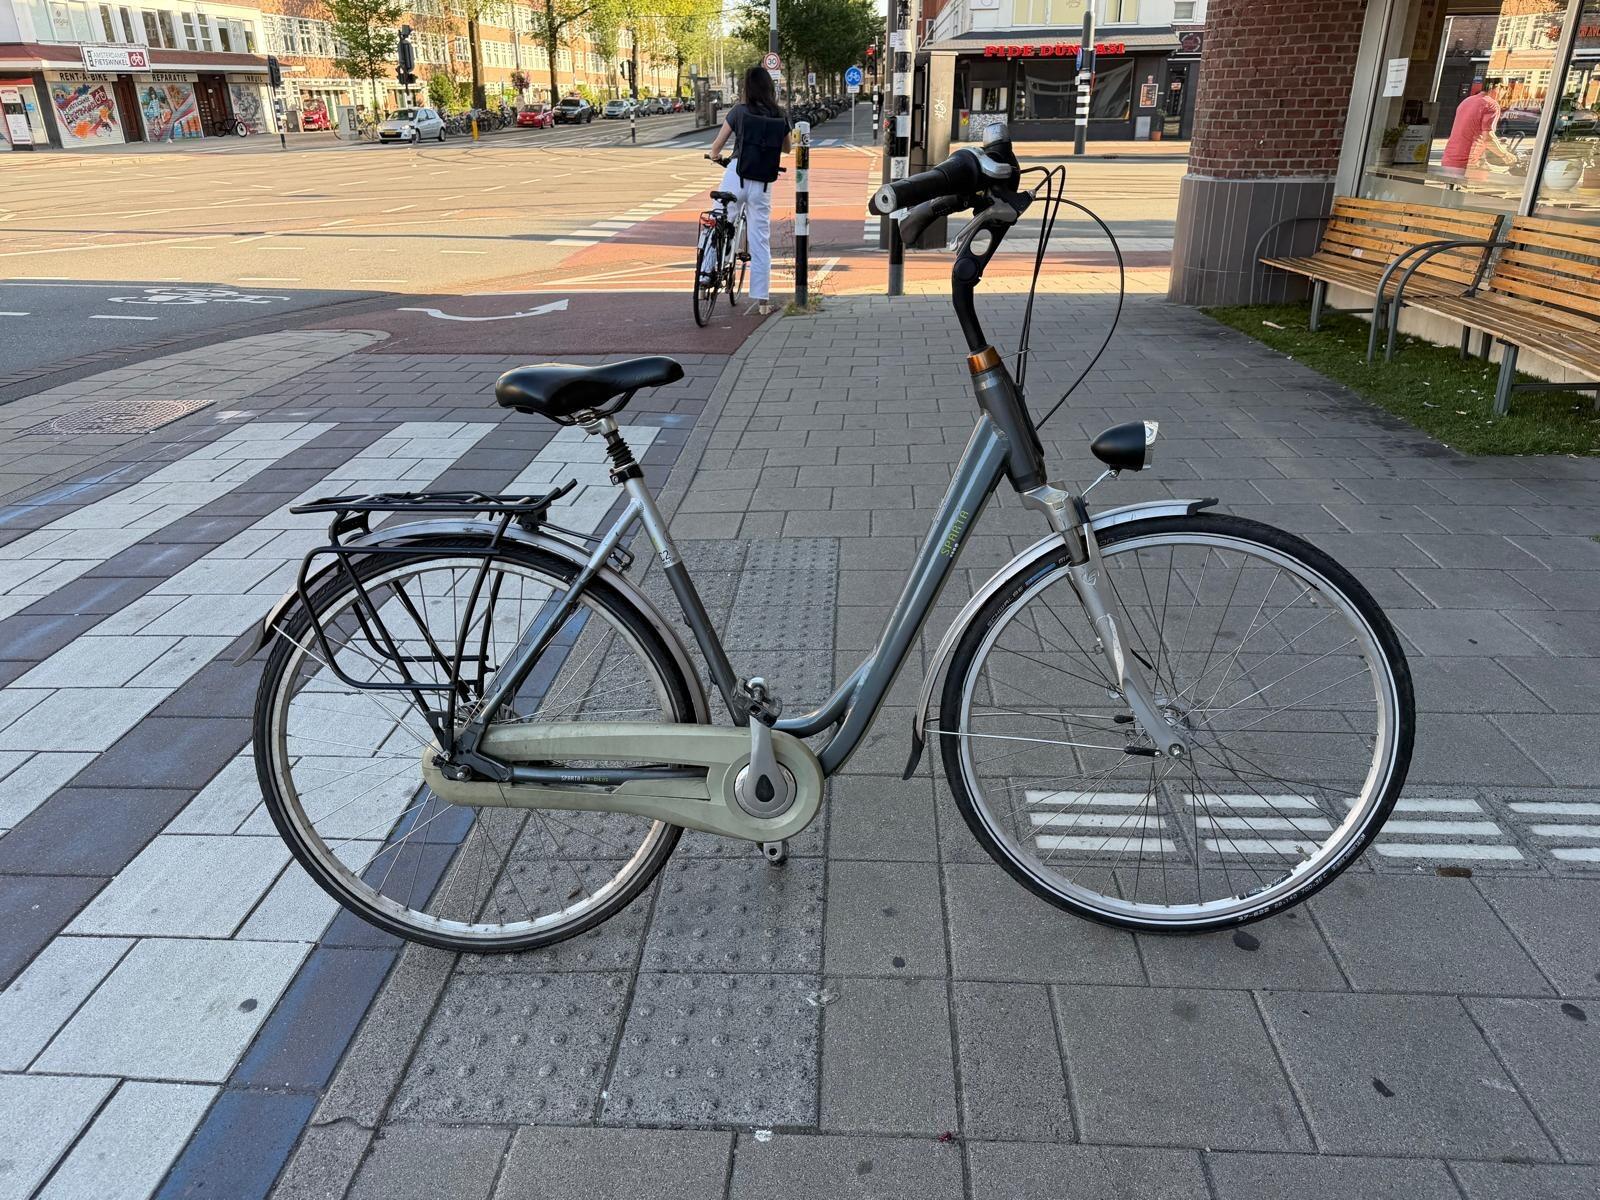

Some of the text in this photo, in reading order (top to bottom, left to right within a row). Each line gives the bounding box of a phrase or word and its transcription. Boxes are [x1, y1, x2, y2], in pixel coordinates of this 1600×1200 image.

[984, 42, 1125, 57] PIDE DÜNASI
[60, 72, 108, 81] RENT-A-BIKE
[152, 72, 187, 82] REPARATIE
[941, 510, 969, 556] SPARTA
[987, 586, 1024, 627] SCHWALBE
